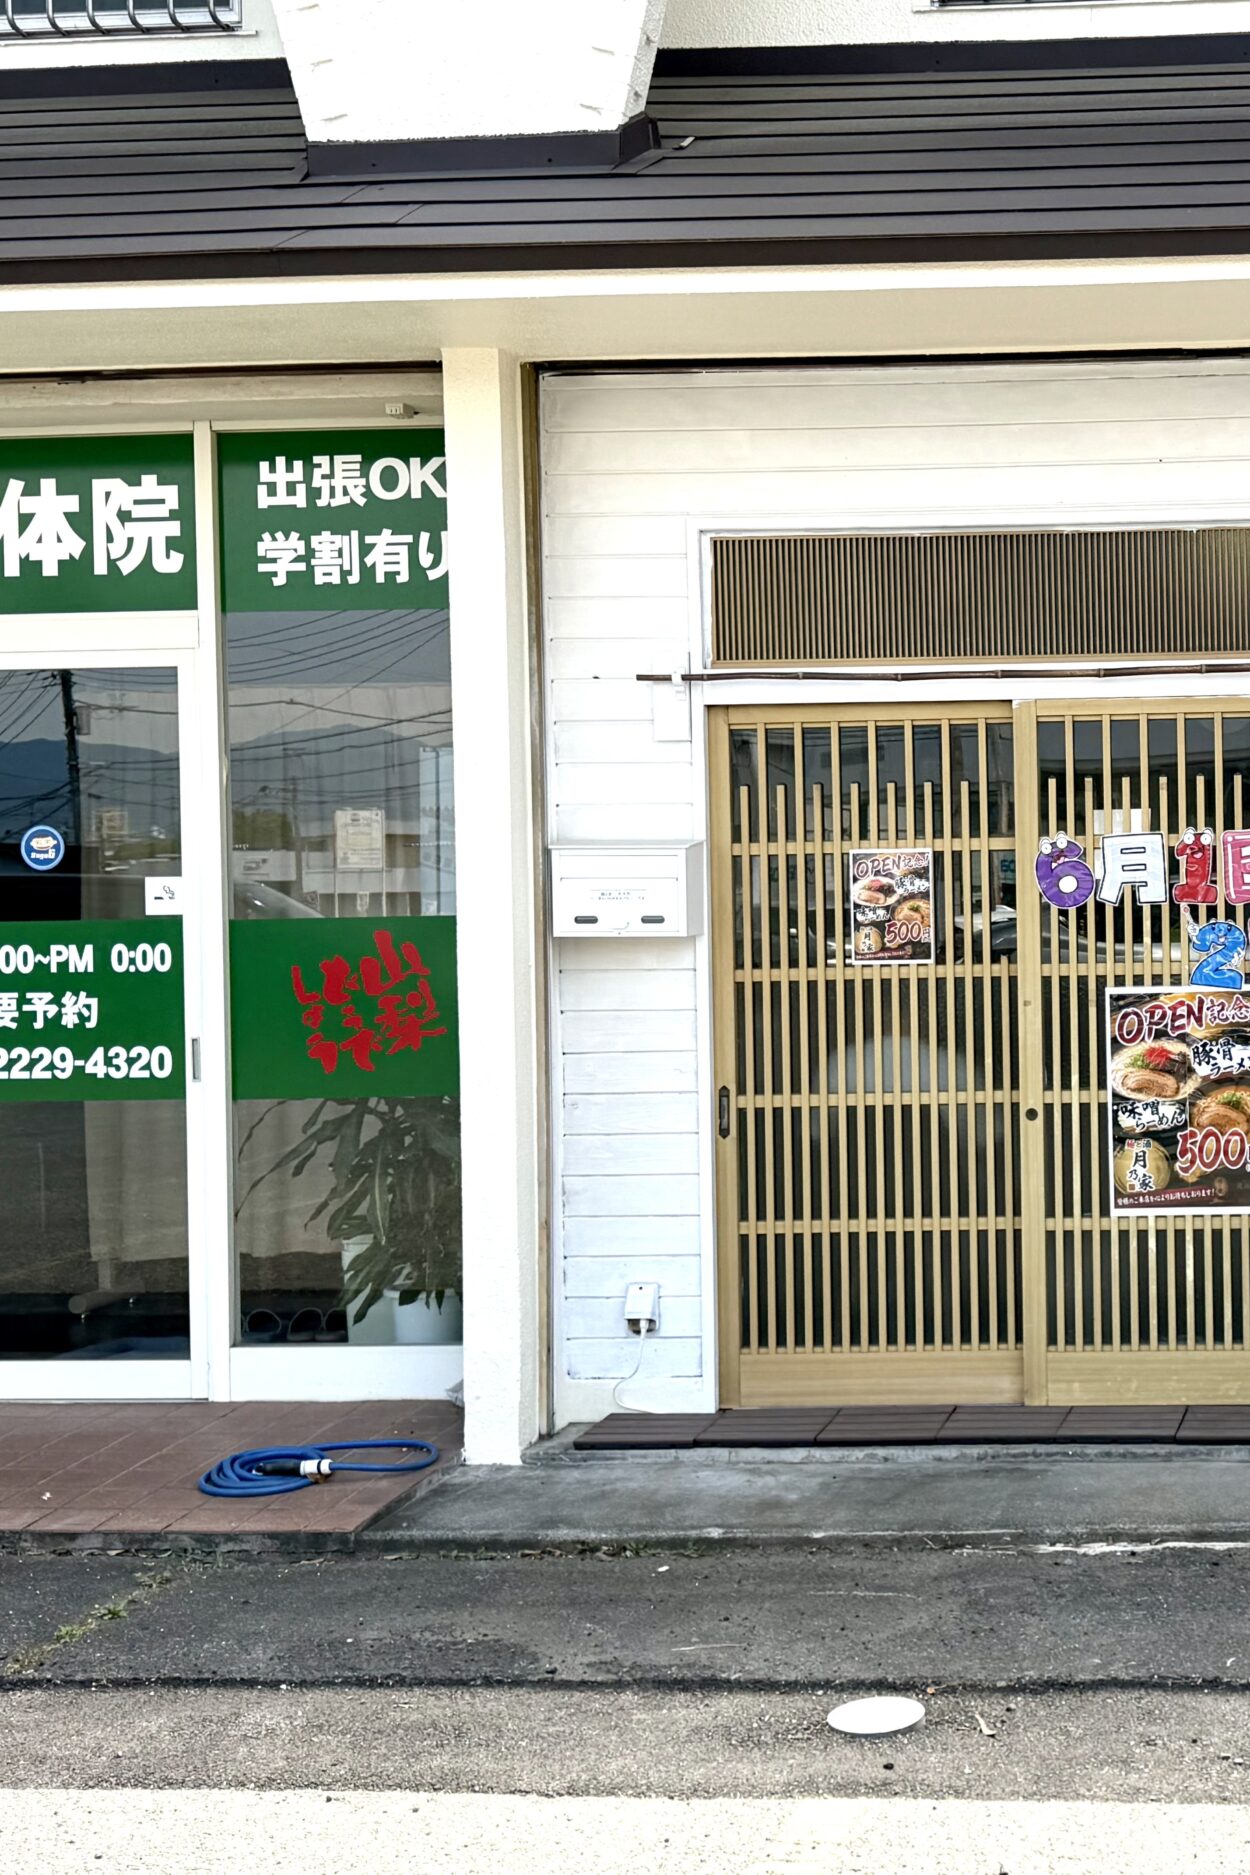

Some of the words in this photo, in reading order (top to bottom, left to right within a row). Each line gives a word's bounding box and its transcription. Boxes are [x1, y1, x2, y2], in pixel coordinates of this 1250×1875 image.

[257, 454, 447, 508] 出張OK
[0, 474, 185, 577] 体院
[257, 528, 448, 587] 学割有り
[110, 942, 172, 974] 0:00
[1191, 1037, 1236, 1069] 豚骨
[1121, 1098, 1160, 1122] 味噌
[1135, 1112, 1185, 1133] らーめん
[1128, 1150, 1153, 1190] 月乃家
